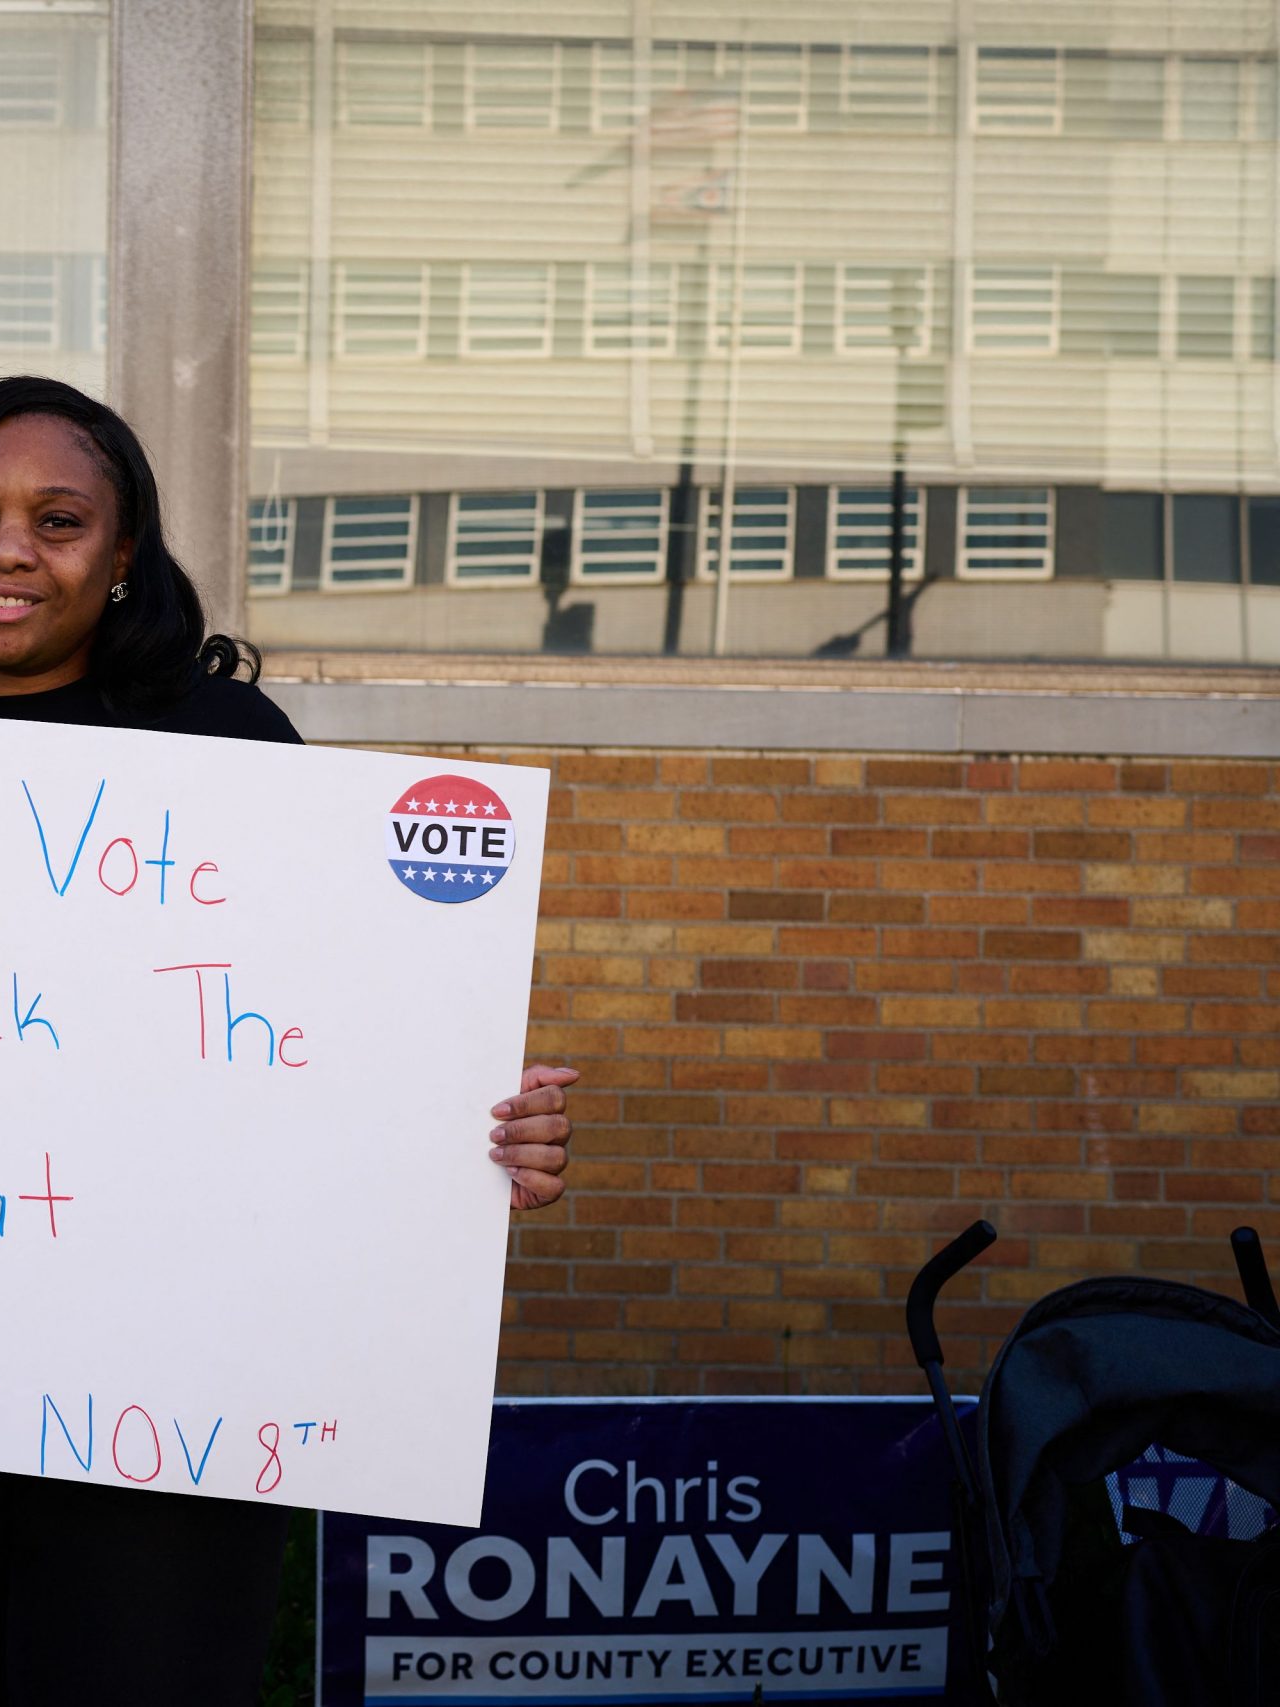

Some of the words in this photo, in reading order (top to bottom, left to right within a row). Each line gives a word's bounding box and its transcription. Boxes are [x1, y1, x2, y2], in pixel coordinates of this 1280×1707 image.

[21, 778, 227, 905] Vote
[392, 820, 506, 859] VOTE
[153, 963, 308, 1067] The
[40, 1393, 222, 1485] NOV
[564, 1459, 762, 1526] Chris
[366, 1531, 951, 1621] RONAYNE
[392, 1650, 474, 1682] FOR
[488, 1649, 672, 1681] COUNTY
[685, 1644, 922, 1678] EXECUTIVE
